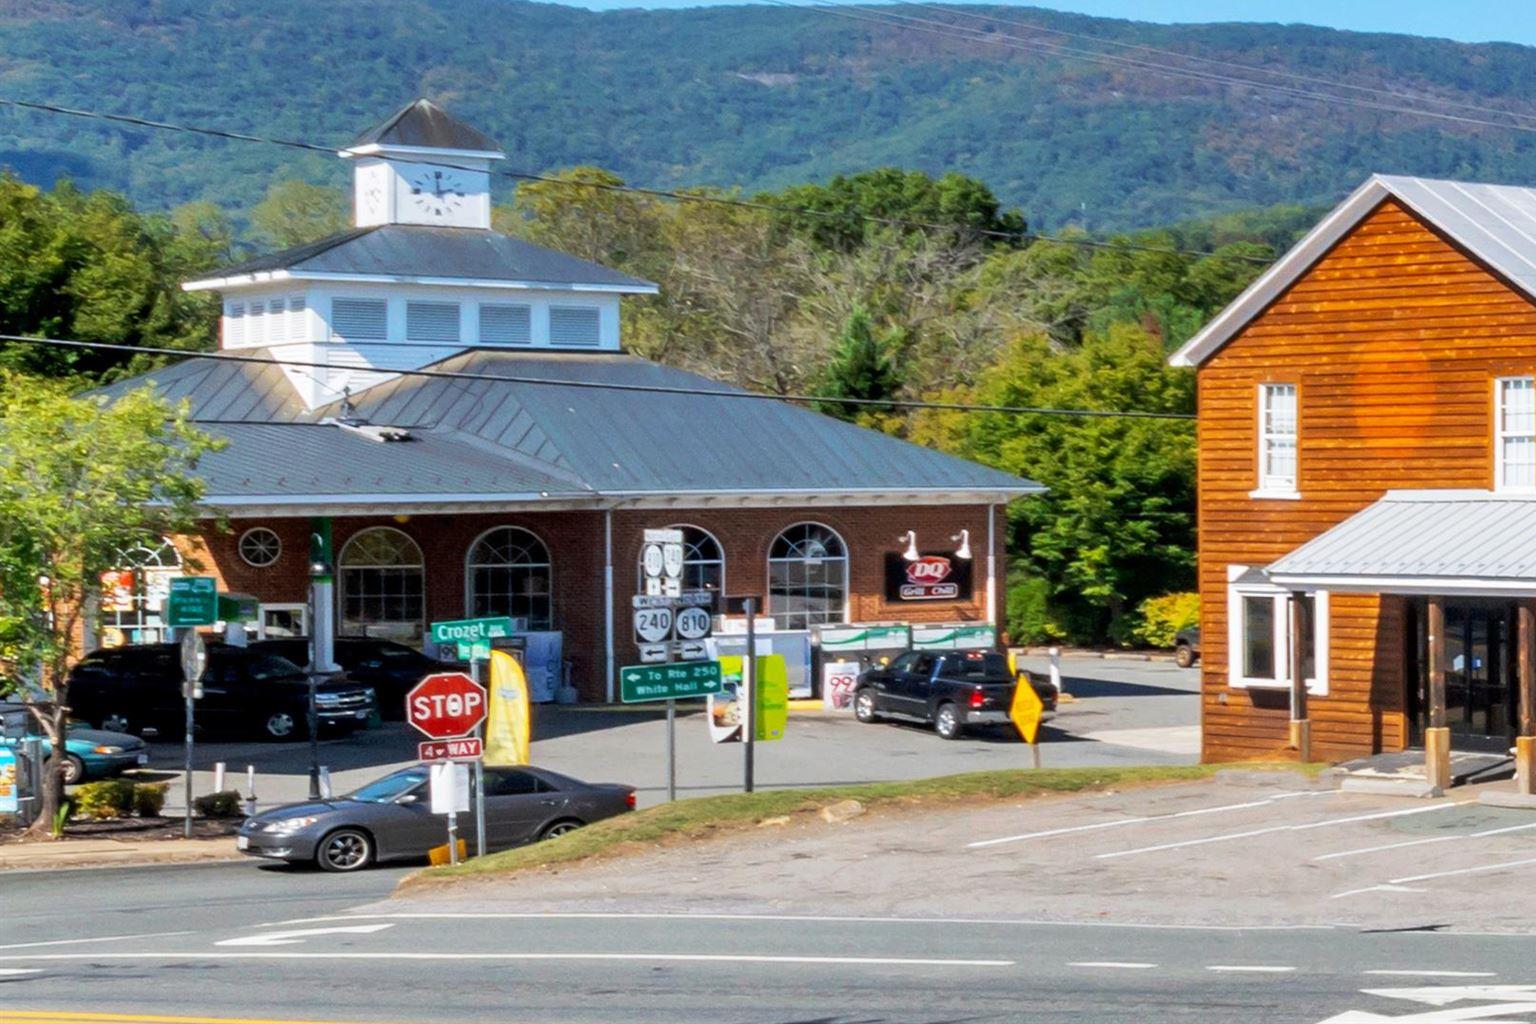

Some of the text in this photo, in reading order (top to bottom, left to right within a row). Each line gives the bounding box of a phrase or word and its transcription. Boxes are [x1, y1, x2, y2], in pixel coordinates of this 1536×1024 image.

[914, 562, 944, 577] DQ
[639, 613, 669, 631] 240
[682, 614, 707, 631] 810
[437, 622, 485, 640] Crozet
[648, 666, 717, 680] To Rte 250
[636, 681, 697, 695] White Hall
[414, 692, 481, 720] STOP
